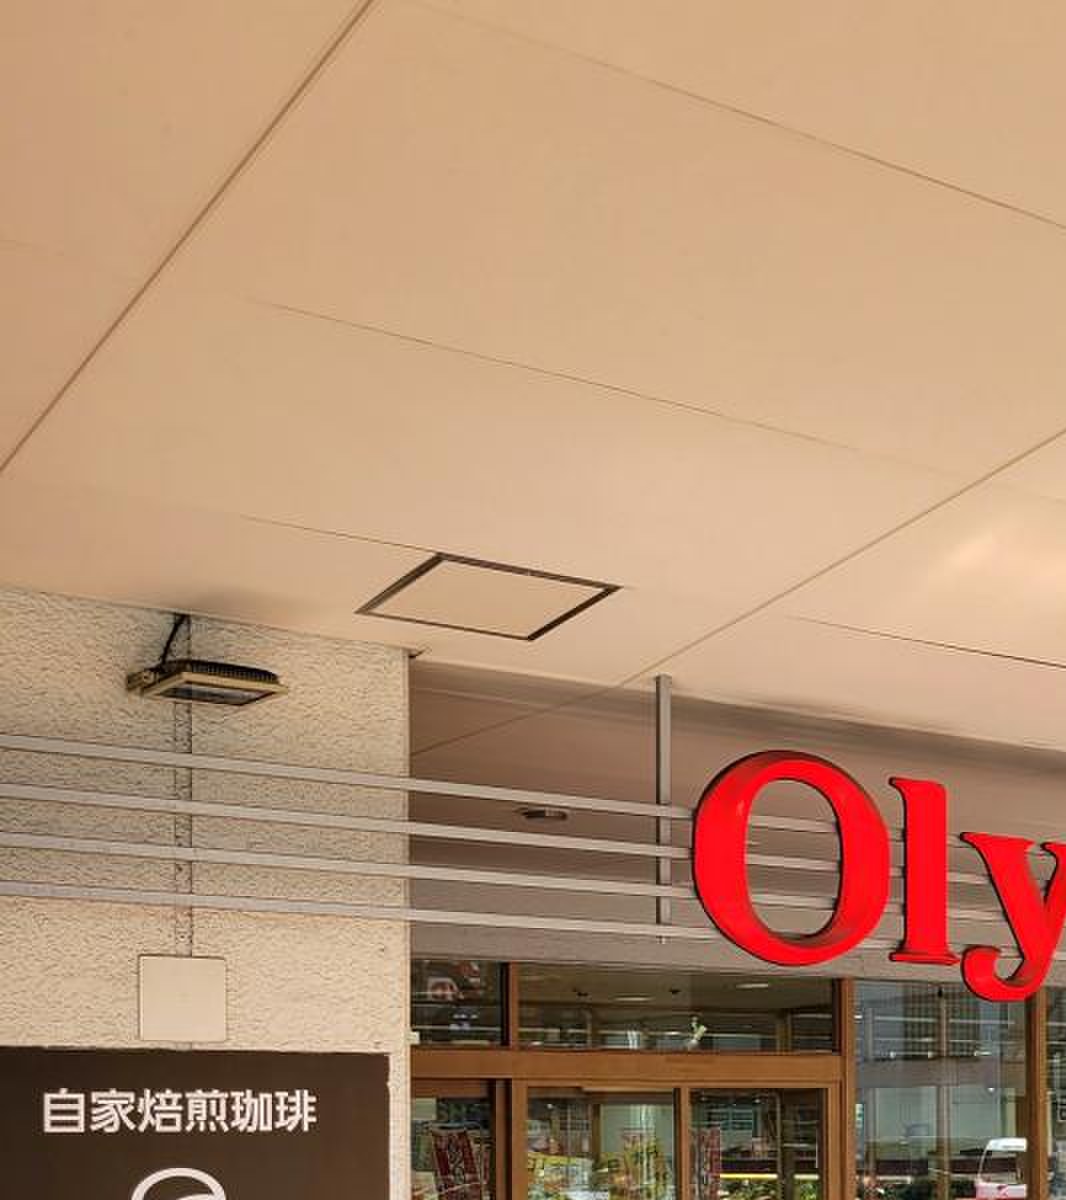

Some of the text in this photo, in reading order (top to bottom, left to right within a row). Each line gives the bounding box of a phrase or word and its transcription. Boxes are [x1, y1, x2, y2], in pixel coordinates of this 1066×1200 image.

[42, 1087, 318, 1134] 自家焙煎珈琲
